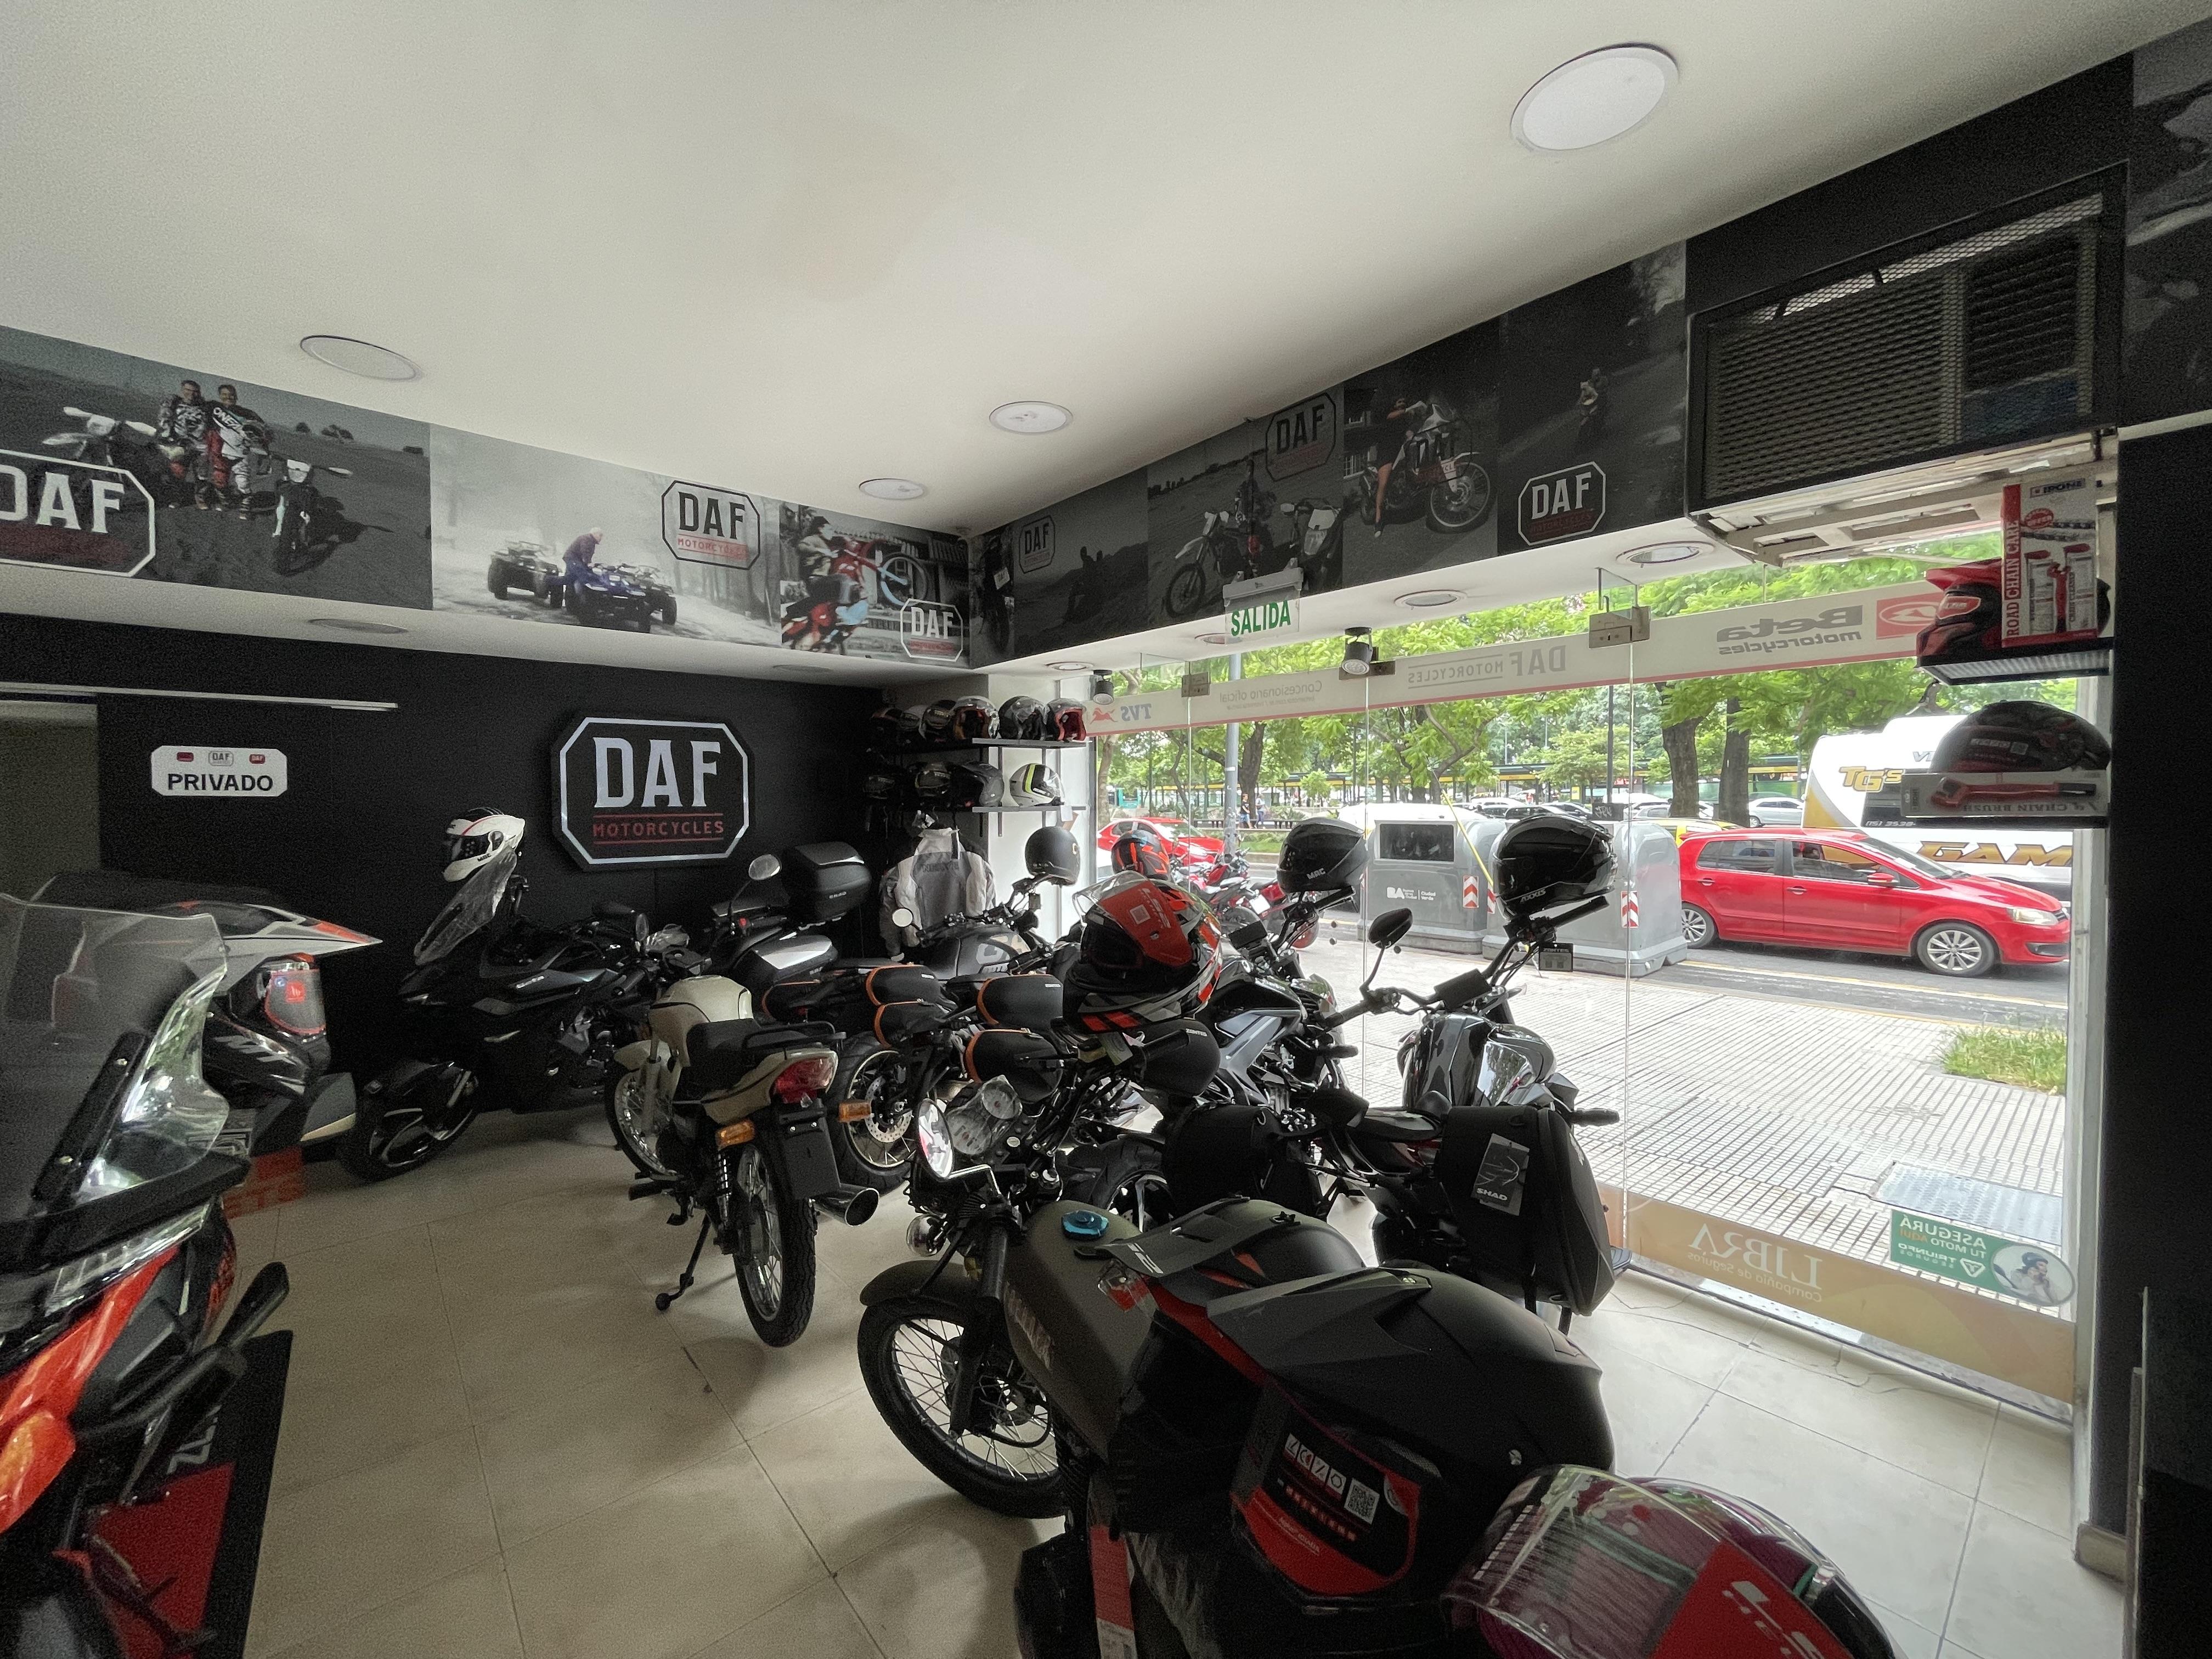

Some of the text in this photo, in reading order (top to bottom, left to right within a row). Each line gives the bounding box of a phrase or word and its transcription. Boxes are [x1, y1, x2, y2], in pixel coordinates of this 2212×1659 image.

[1277, 403, 1325, 455] DAF
[1532, 472, 1592, 520] DAF
[679, 491, 746, 539] DAF
[1024, 522, 1049, 555] DAF
[2006, 520, 2020, 636] ROAD CHAIN CARE
[910, 606, 953, 640] DAF
[1231, 600, 1291, 636] SALIDA
[212, 752, 230, 761] DAF
[592, 737, 721, 808] DAF
[167, 773, 273, 791] PRIVADO
[592, 820, 724, 837] MOTORCYCLES
[1386, 887, 1405, 899] BA
[1477, 1188, 1508, 1201] SHAD
